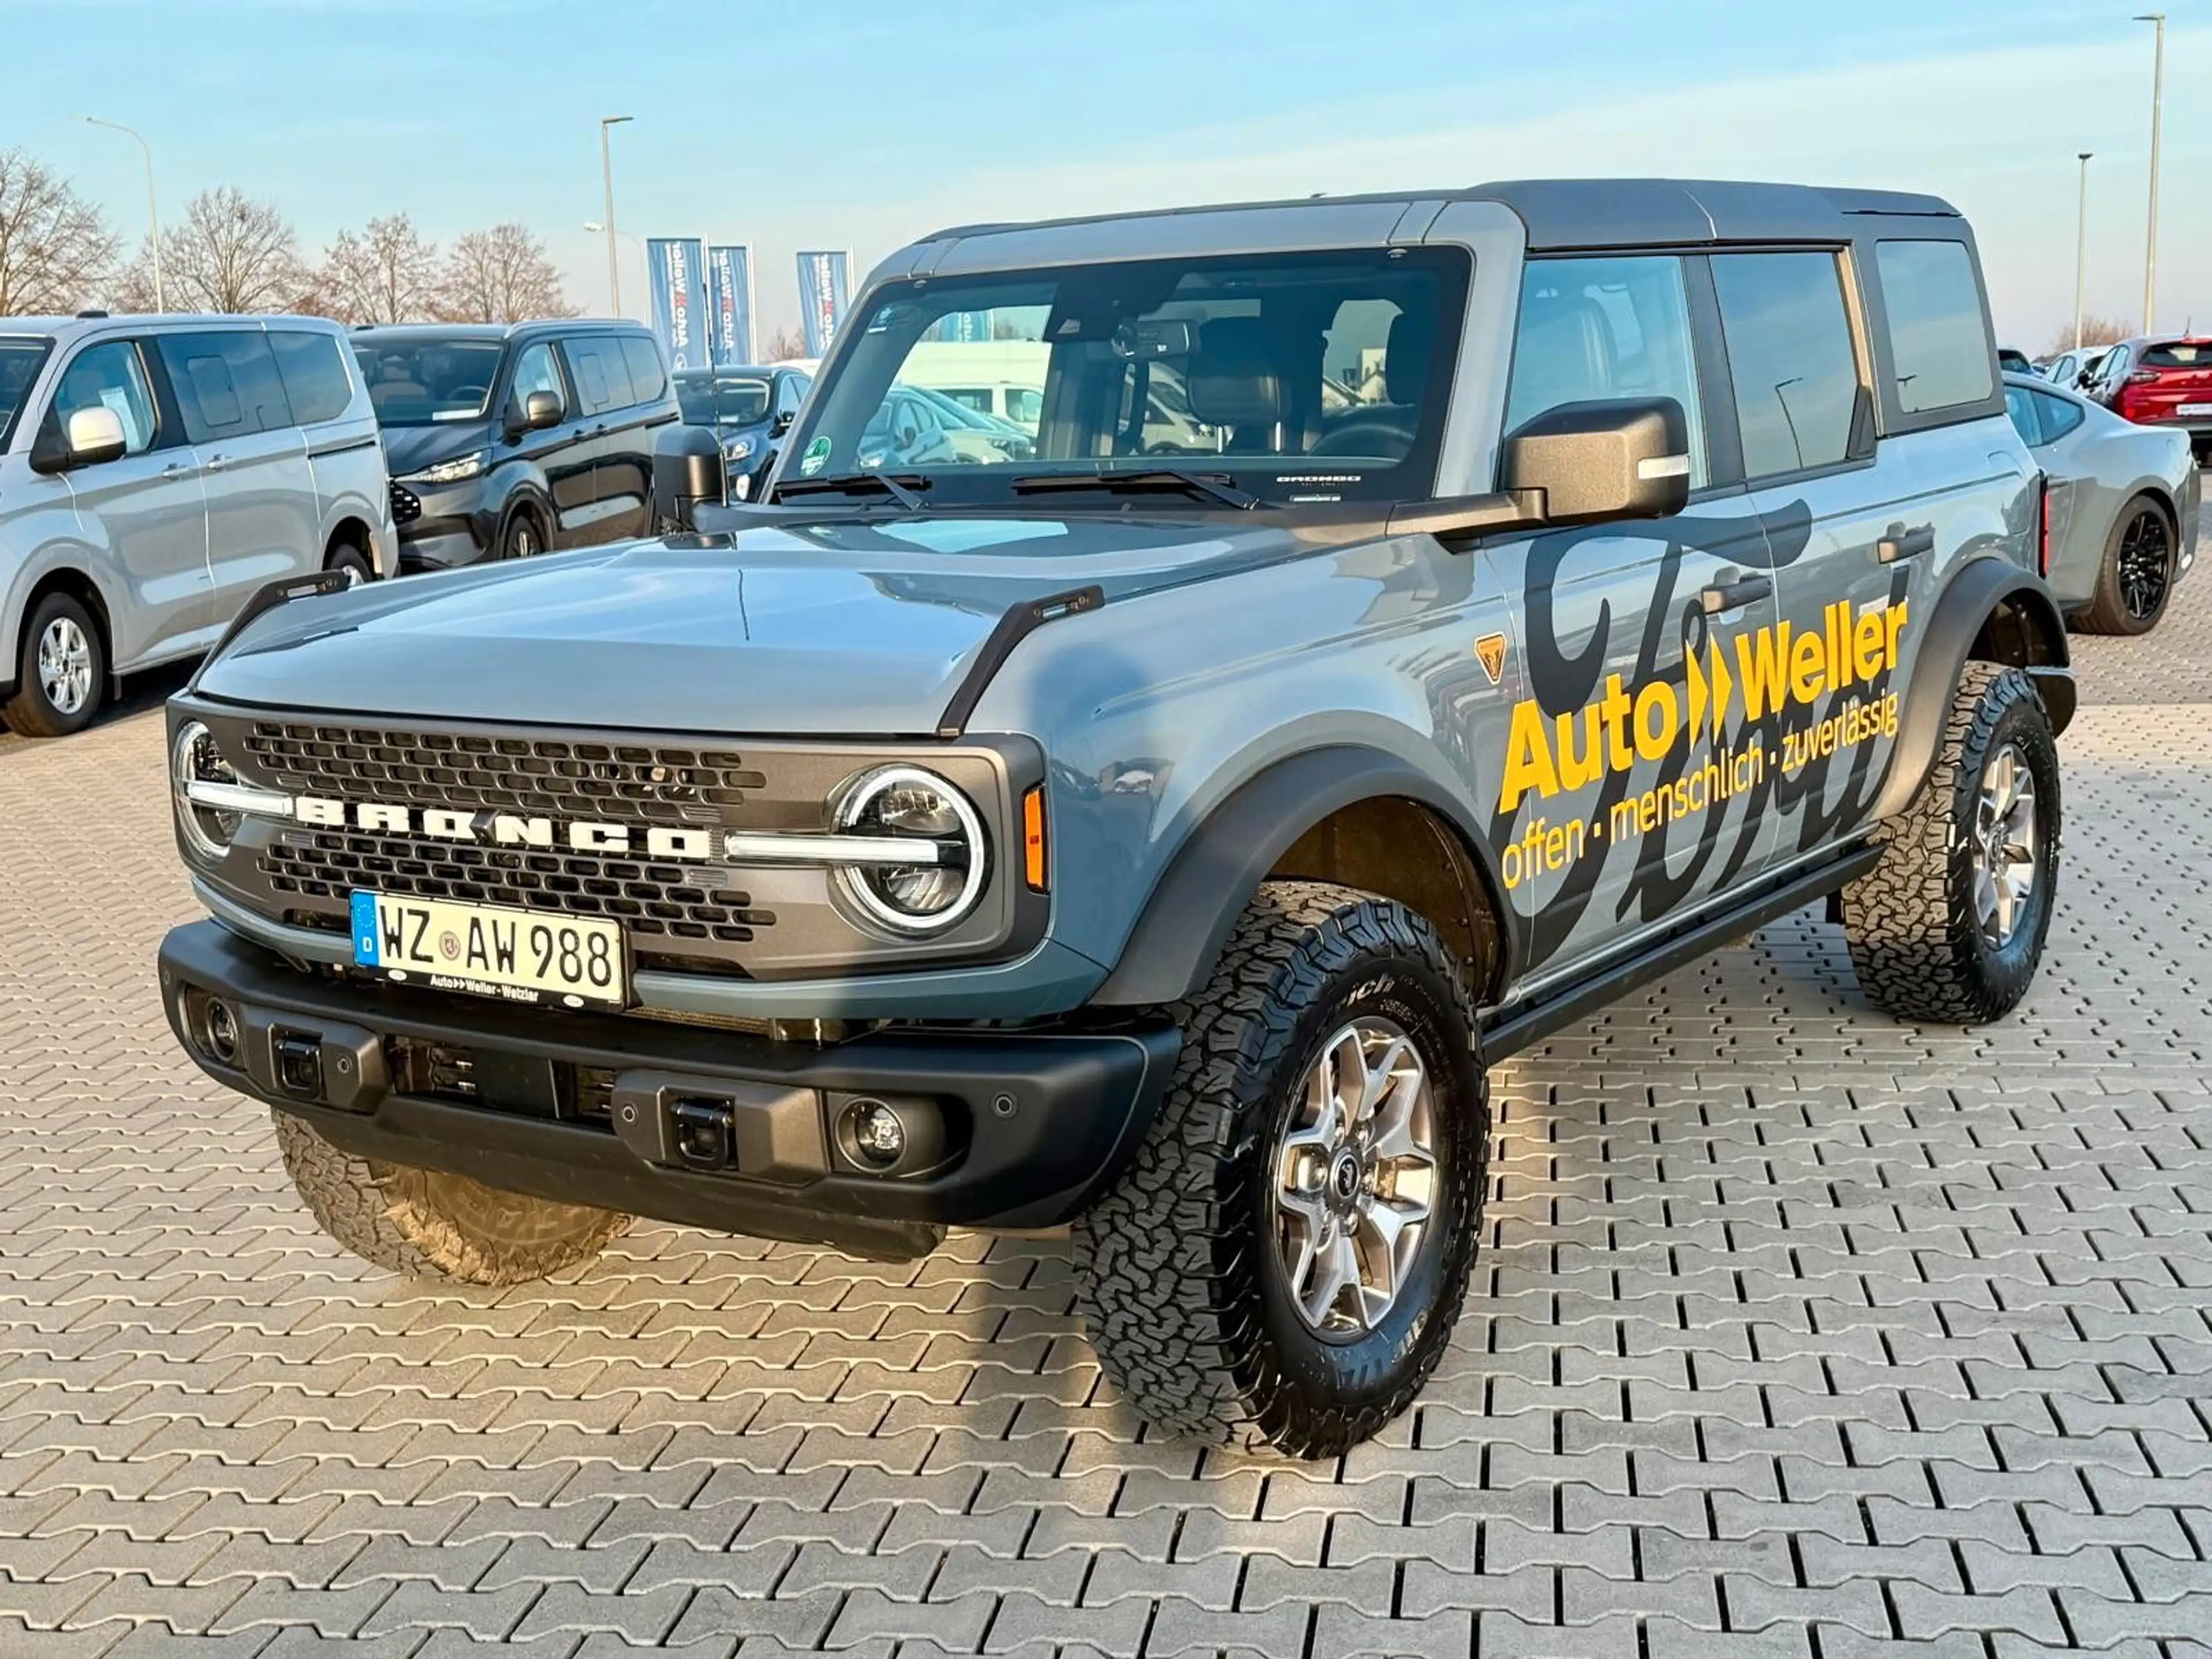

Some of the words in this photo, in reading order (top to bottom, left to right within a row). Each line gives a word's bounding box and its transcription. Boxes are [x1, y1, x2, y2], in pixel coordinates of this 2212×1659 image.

[1499, 673, 1679, 814] Auto
[1735, 599, 1909, 721] Weller
[296, 797, 711, 858] BRONCO
[1501, 819, 1585, 889] offen
[1610, 743, 1764, 846] menschlich
[1781, 691, 1899, 774] zuverlässig
[362, 938, 373, 953] D
[380, 906, 433, 962] WZ
[467, 917, 516, 974] AW
[530, 925, 612, 986] 988
